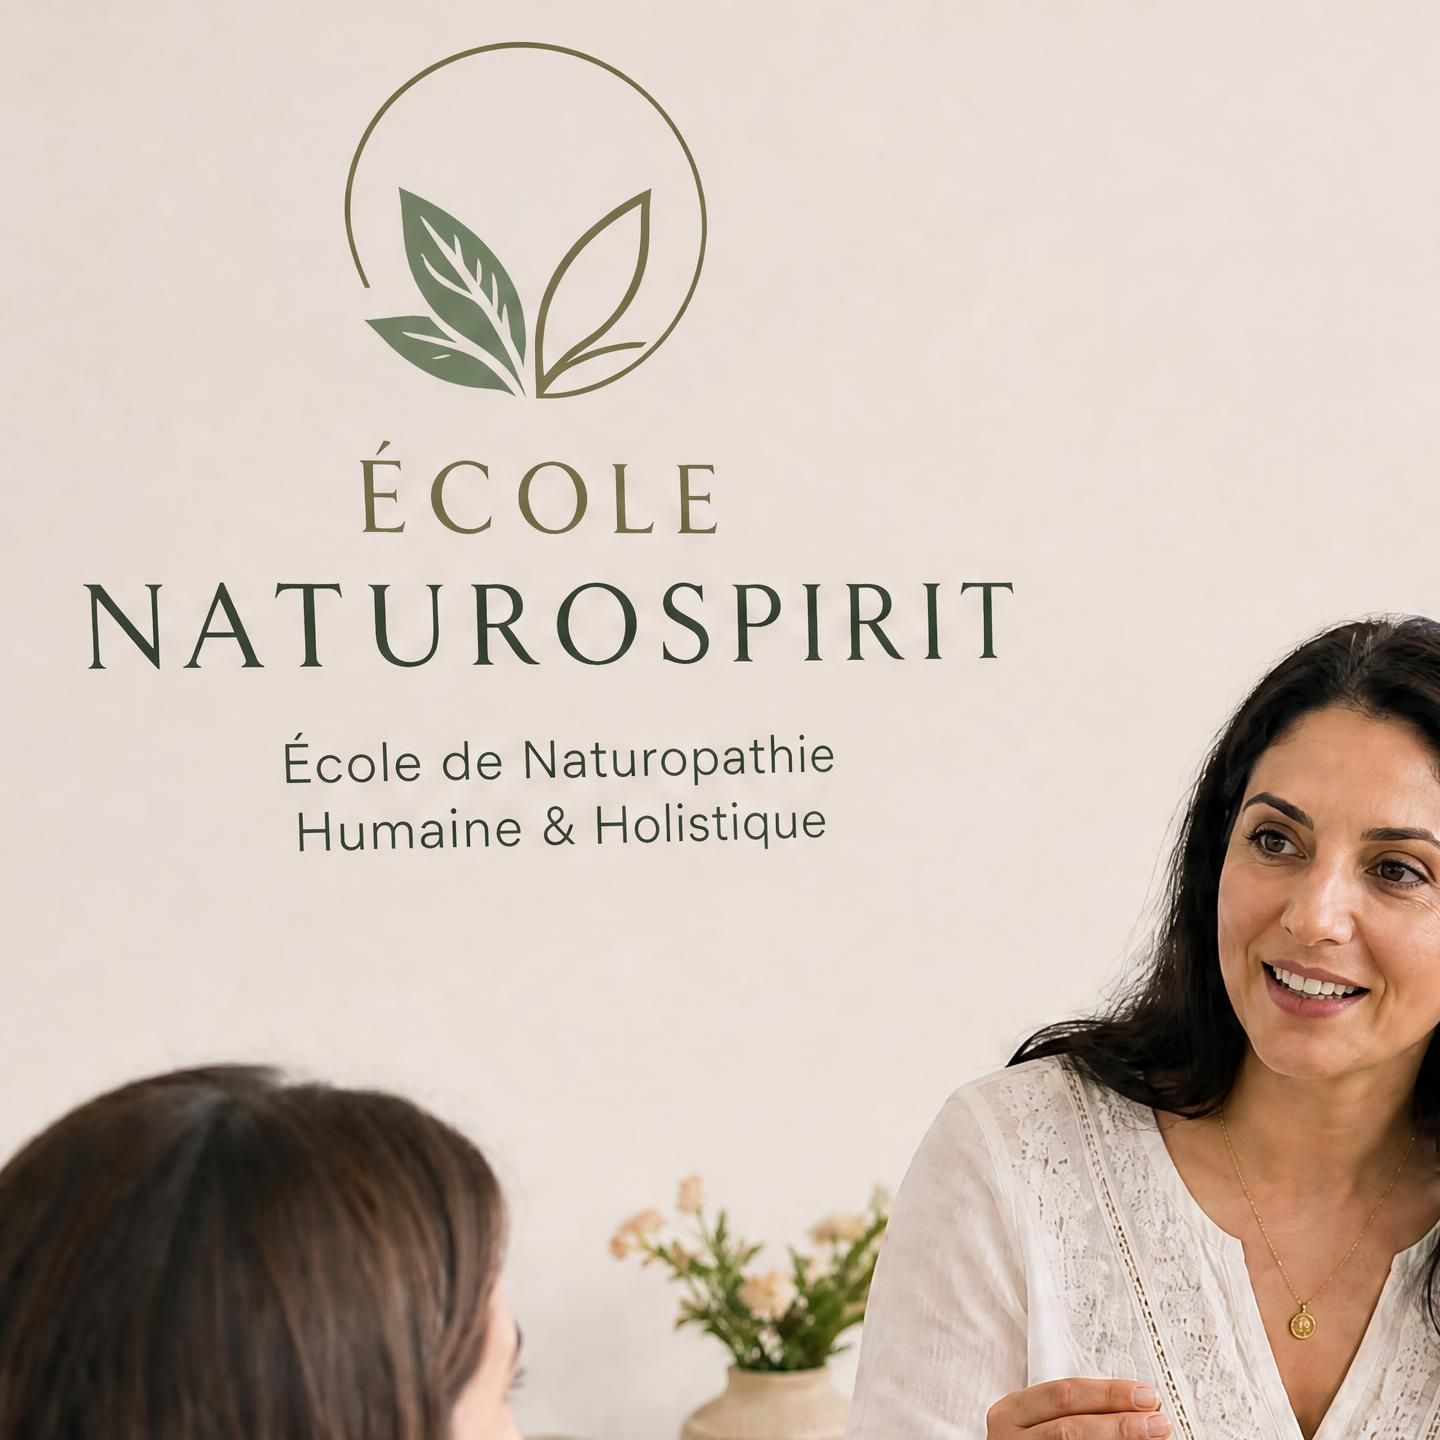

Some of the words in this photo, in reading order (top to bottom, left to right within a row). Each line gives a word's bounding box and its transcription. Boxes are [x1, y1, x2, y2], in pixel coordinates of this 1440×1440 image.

[359, 440, 718, 535] ÉCOLE
[82, 581, 1014, 670] NATUROSPIRIT
[284, 732, 421, 784] École
[442, 740, 503, 781] de
[524, 734, 834, 786] Naturopathie
[298, 807, 522, 852] Humaine
[543, 805, 576, 846] &
[596, 801, 826, 850] Holistique
